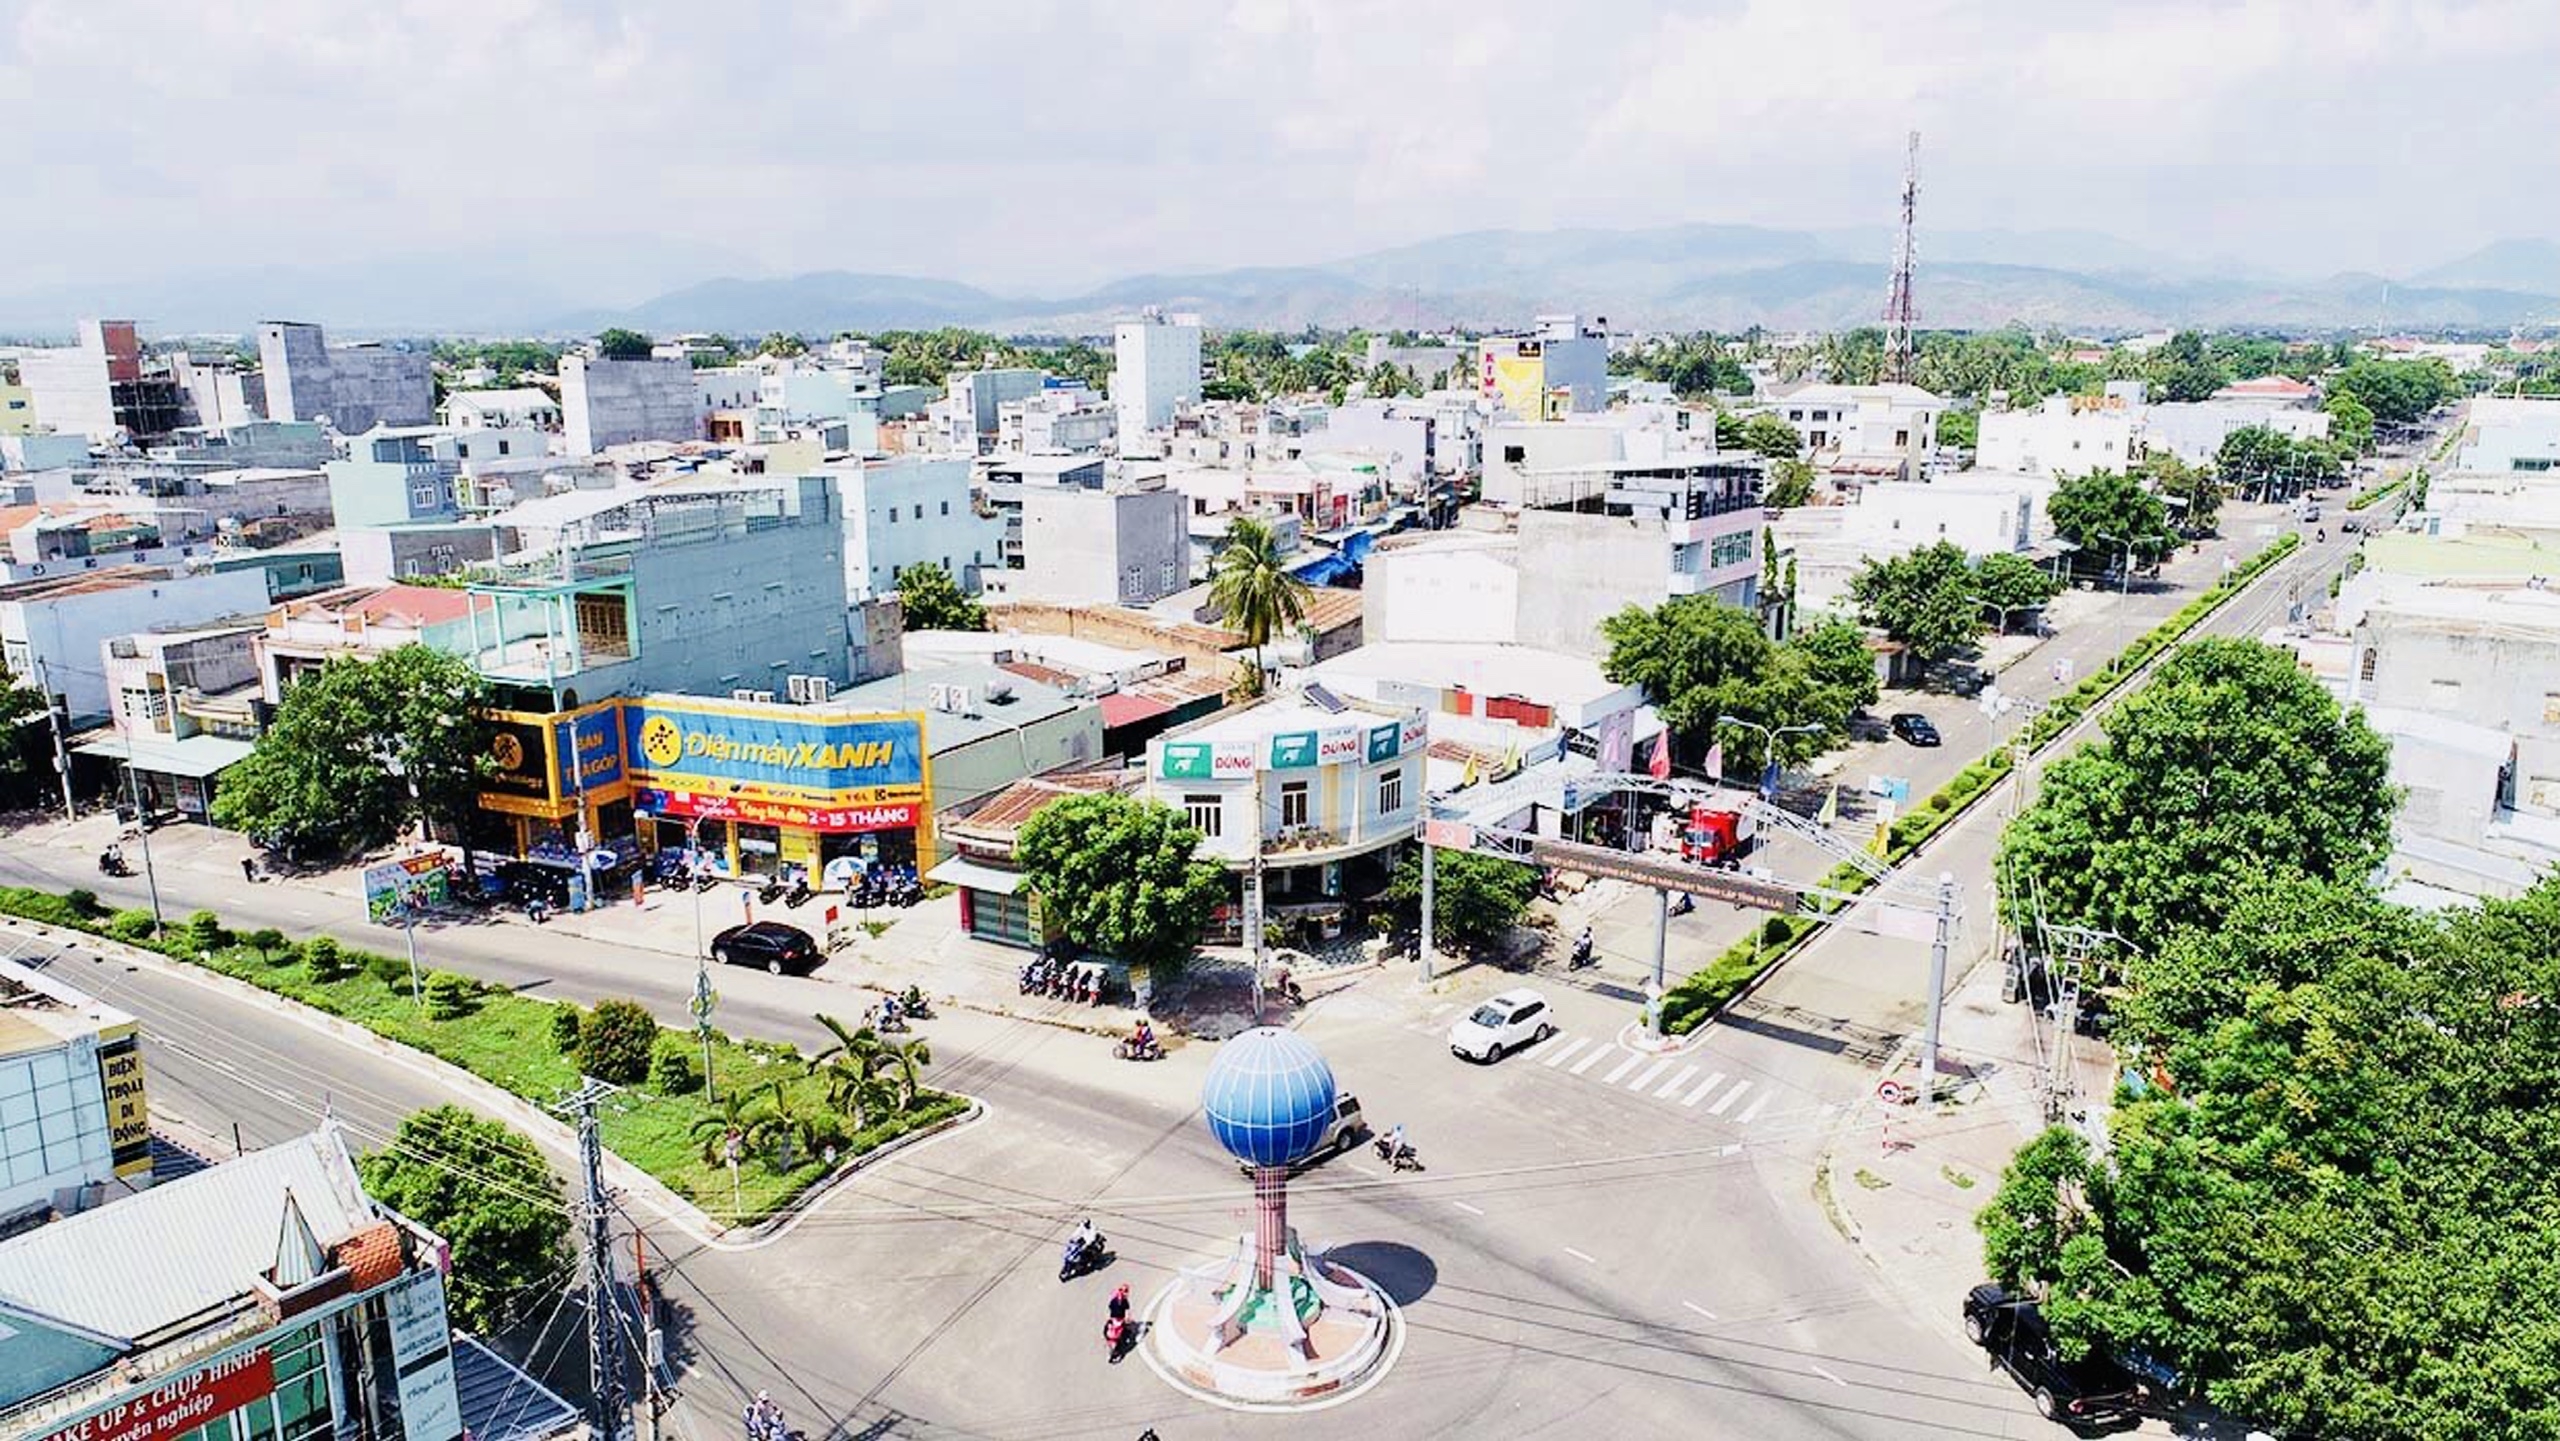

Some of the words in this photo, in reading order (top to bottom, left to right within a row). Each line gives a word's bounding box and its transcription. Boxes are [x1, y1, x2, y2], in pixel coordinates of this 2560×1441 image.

[685, 732, 740, 763] Điện
[741, 739, 797, 771] máy
[796, 741, 893, 768] XANH
[829, 812, 846, 826] 15
[848, 807, 909, 825] THÁNG
[121, 1103, 134, 1118] DI
[44, 1419, 92, 1441] KE
[99, 1406, 127, 1432] UP
[133, 1399, 146, 1417] &
[152, 1370, 204, 1407] CHỤP
[157, 1393, 214, 1429] nghiệp
